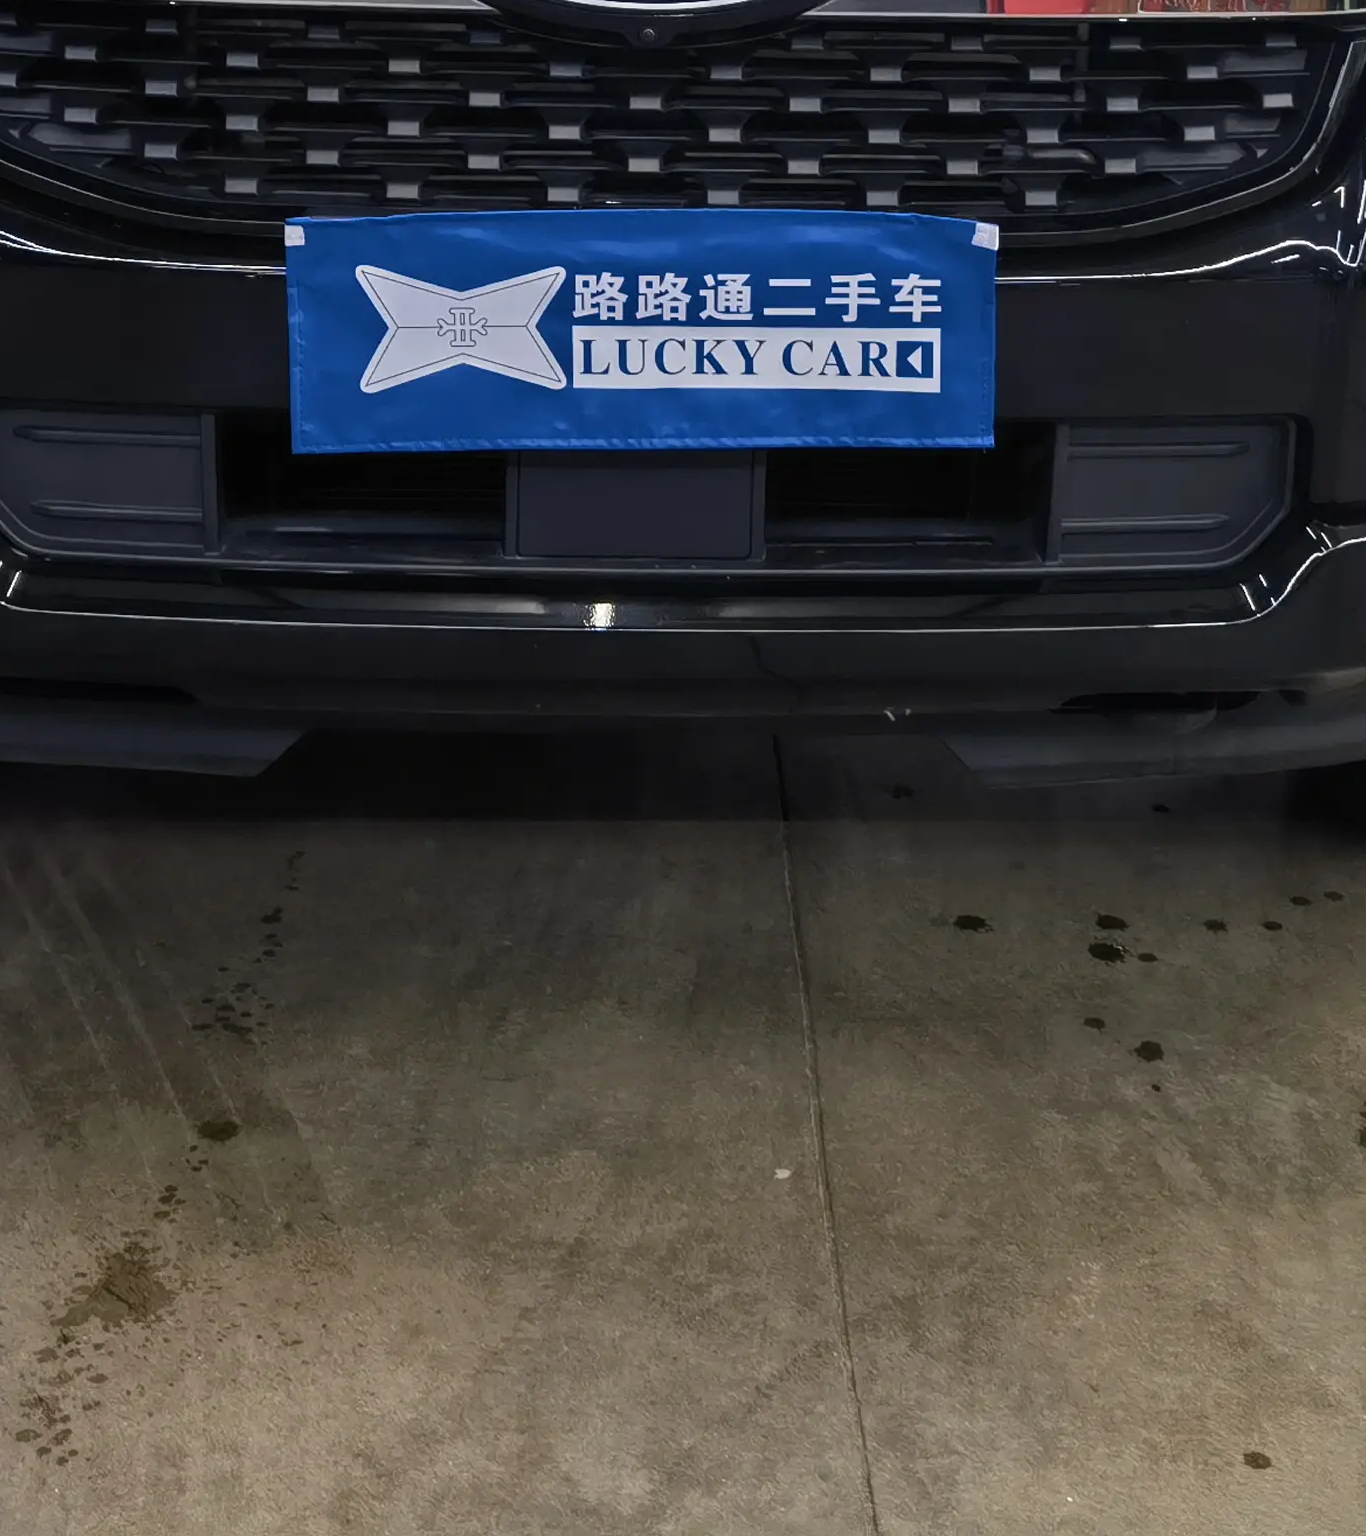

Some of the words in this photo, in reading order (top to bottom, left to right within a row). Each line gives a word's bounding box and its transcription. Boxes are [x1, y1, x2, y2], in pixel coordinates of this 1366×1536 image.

[572, 271, 942, 323] 路路通二手车
[579, 338, 767, 376] LUCKY
[781, 339, 891, 378] CAR
